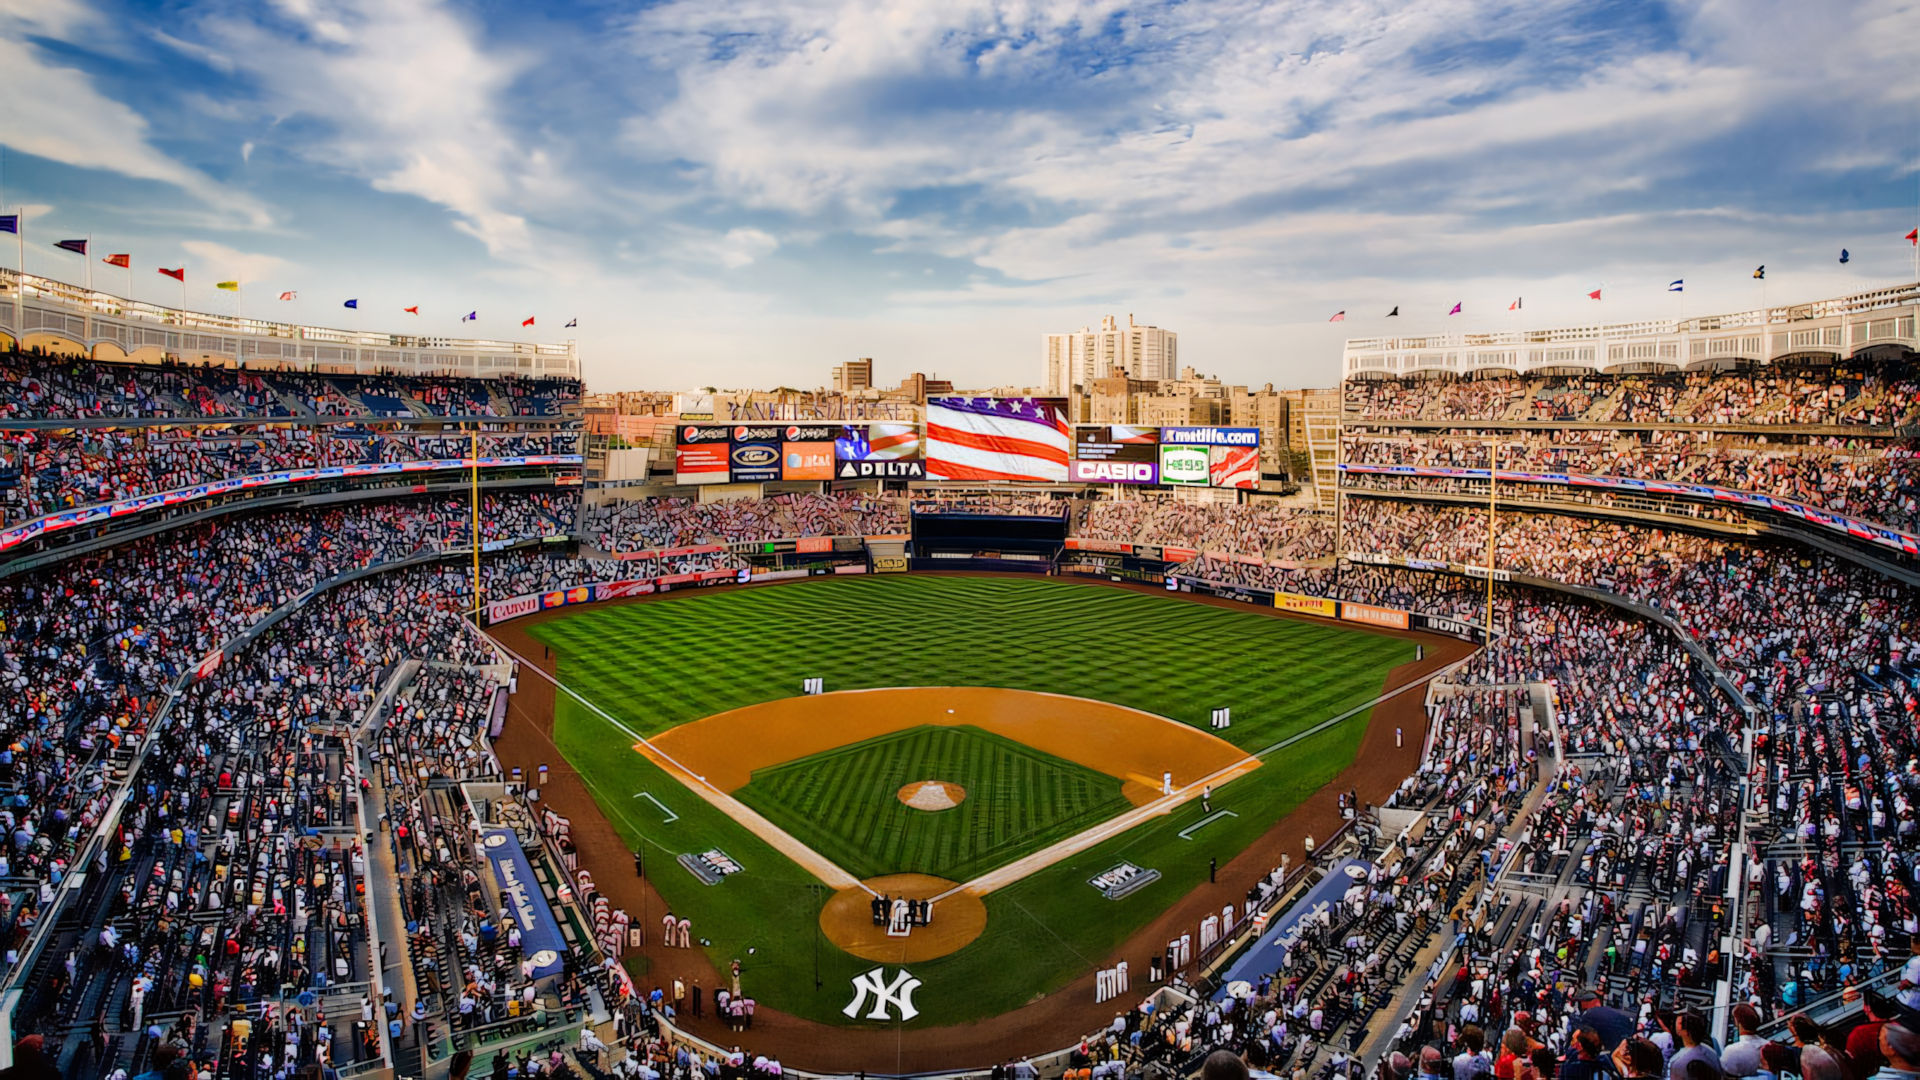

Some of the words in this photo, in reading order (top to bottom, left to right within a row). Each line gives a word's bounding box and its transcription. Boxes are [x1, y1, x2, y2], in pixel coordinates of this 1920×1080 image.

[861, 462, 922, 477] DELTA
[1077, 463, 1153, 481] CASIO
[842, 967, 922, 1022] NY
